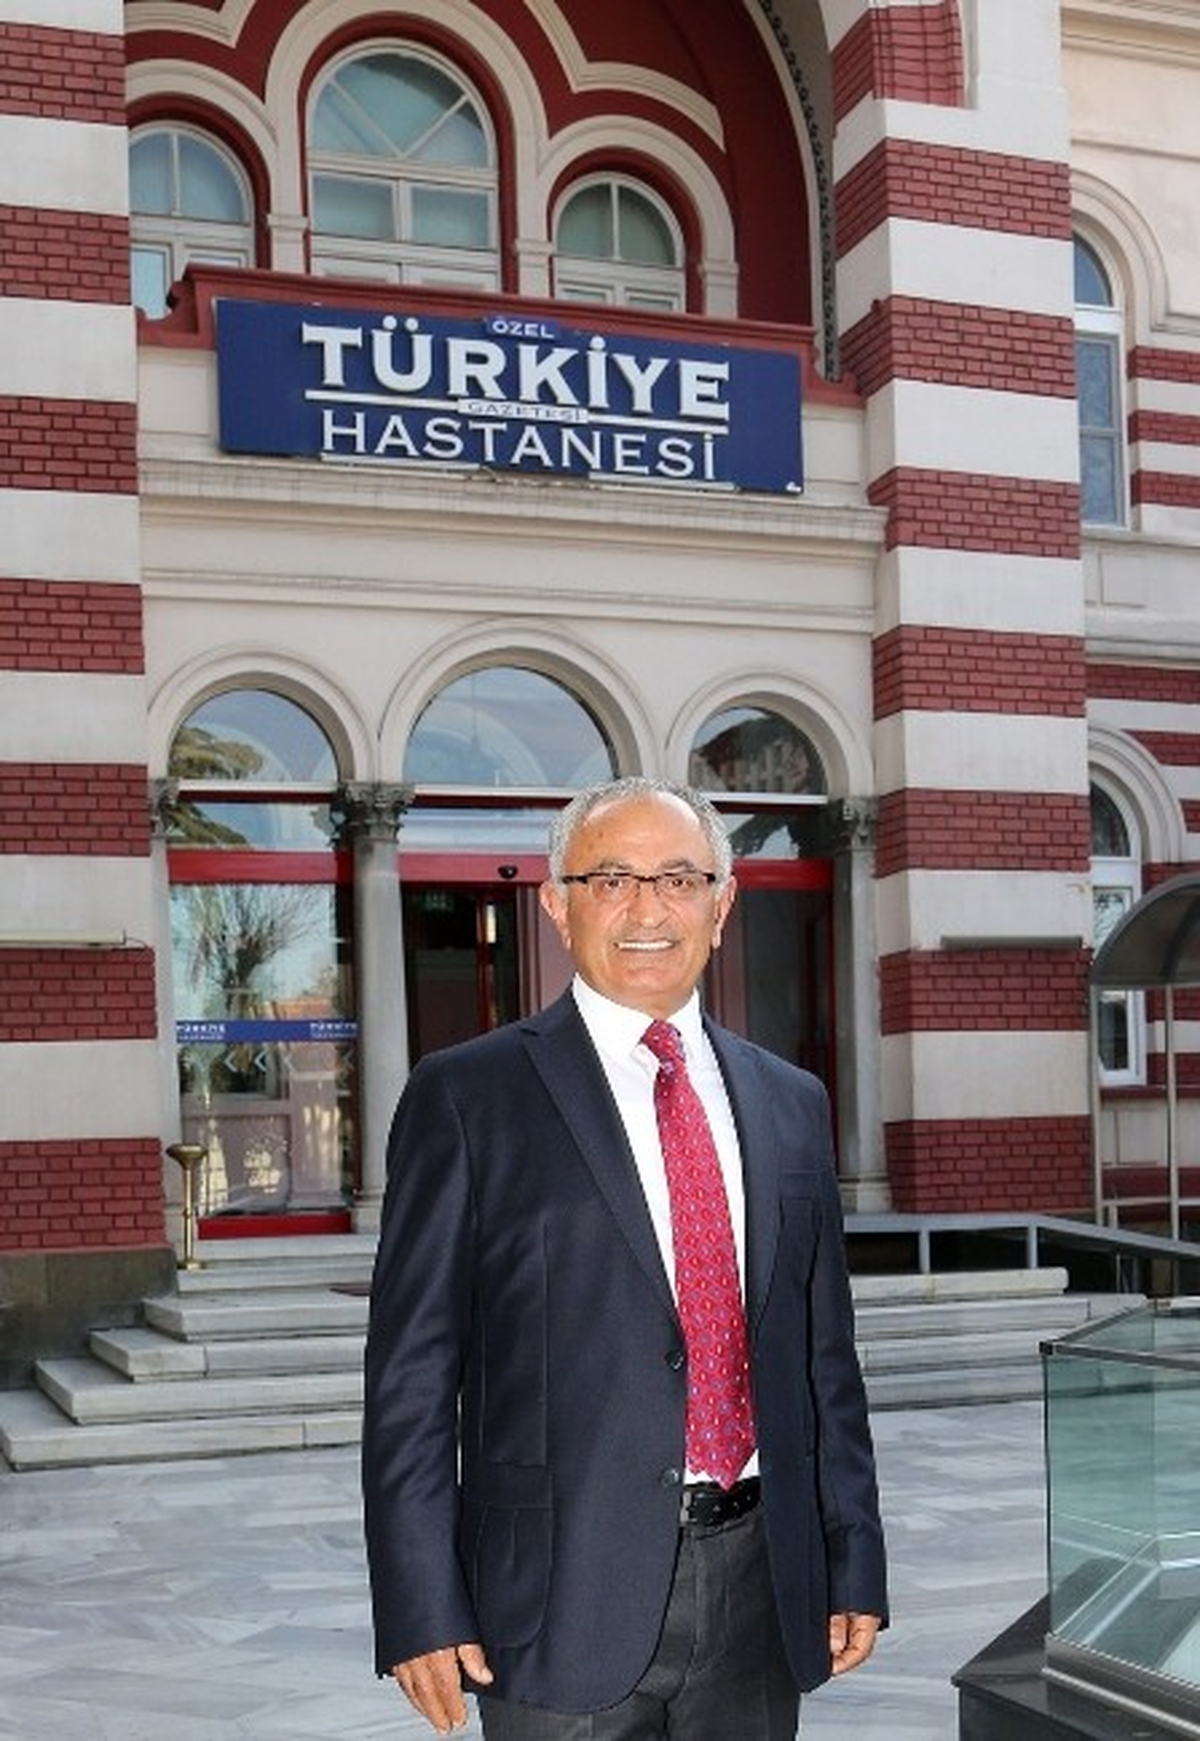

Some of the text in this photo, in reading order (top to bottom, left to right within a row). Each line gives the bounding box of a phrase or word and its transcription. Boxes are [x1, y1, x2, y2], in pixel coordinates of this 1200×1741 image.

[492, 317, 555, 339] ÖZEL
[302, 316, 730, 421] TÜRKİYE
[468, 401, 581, 423] GAZETESİ
[323, 411, 715, 480] HASTANESİ
